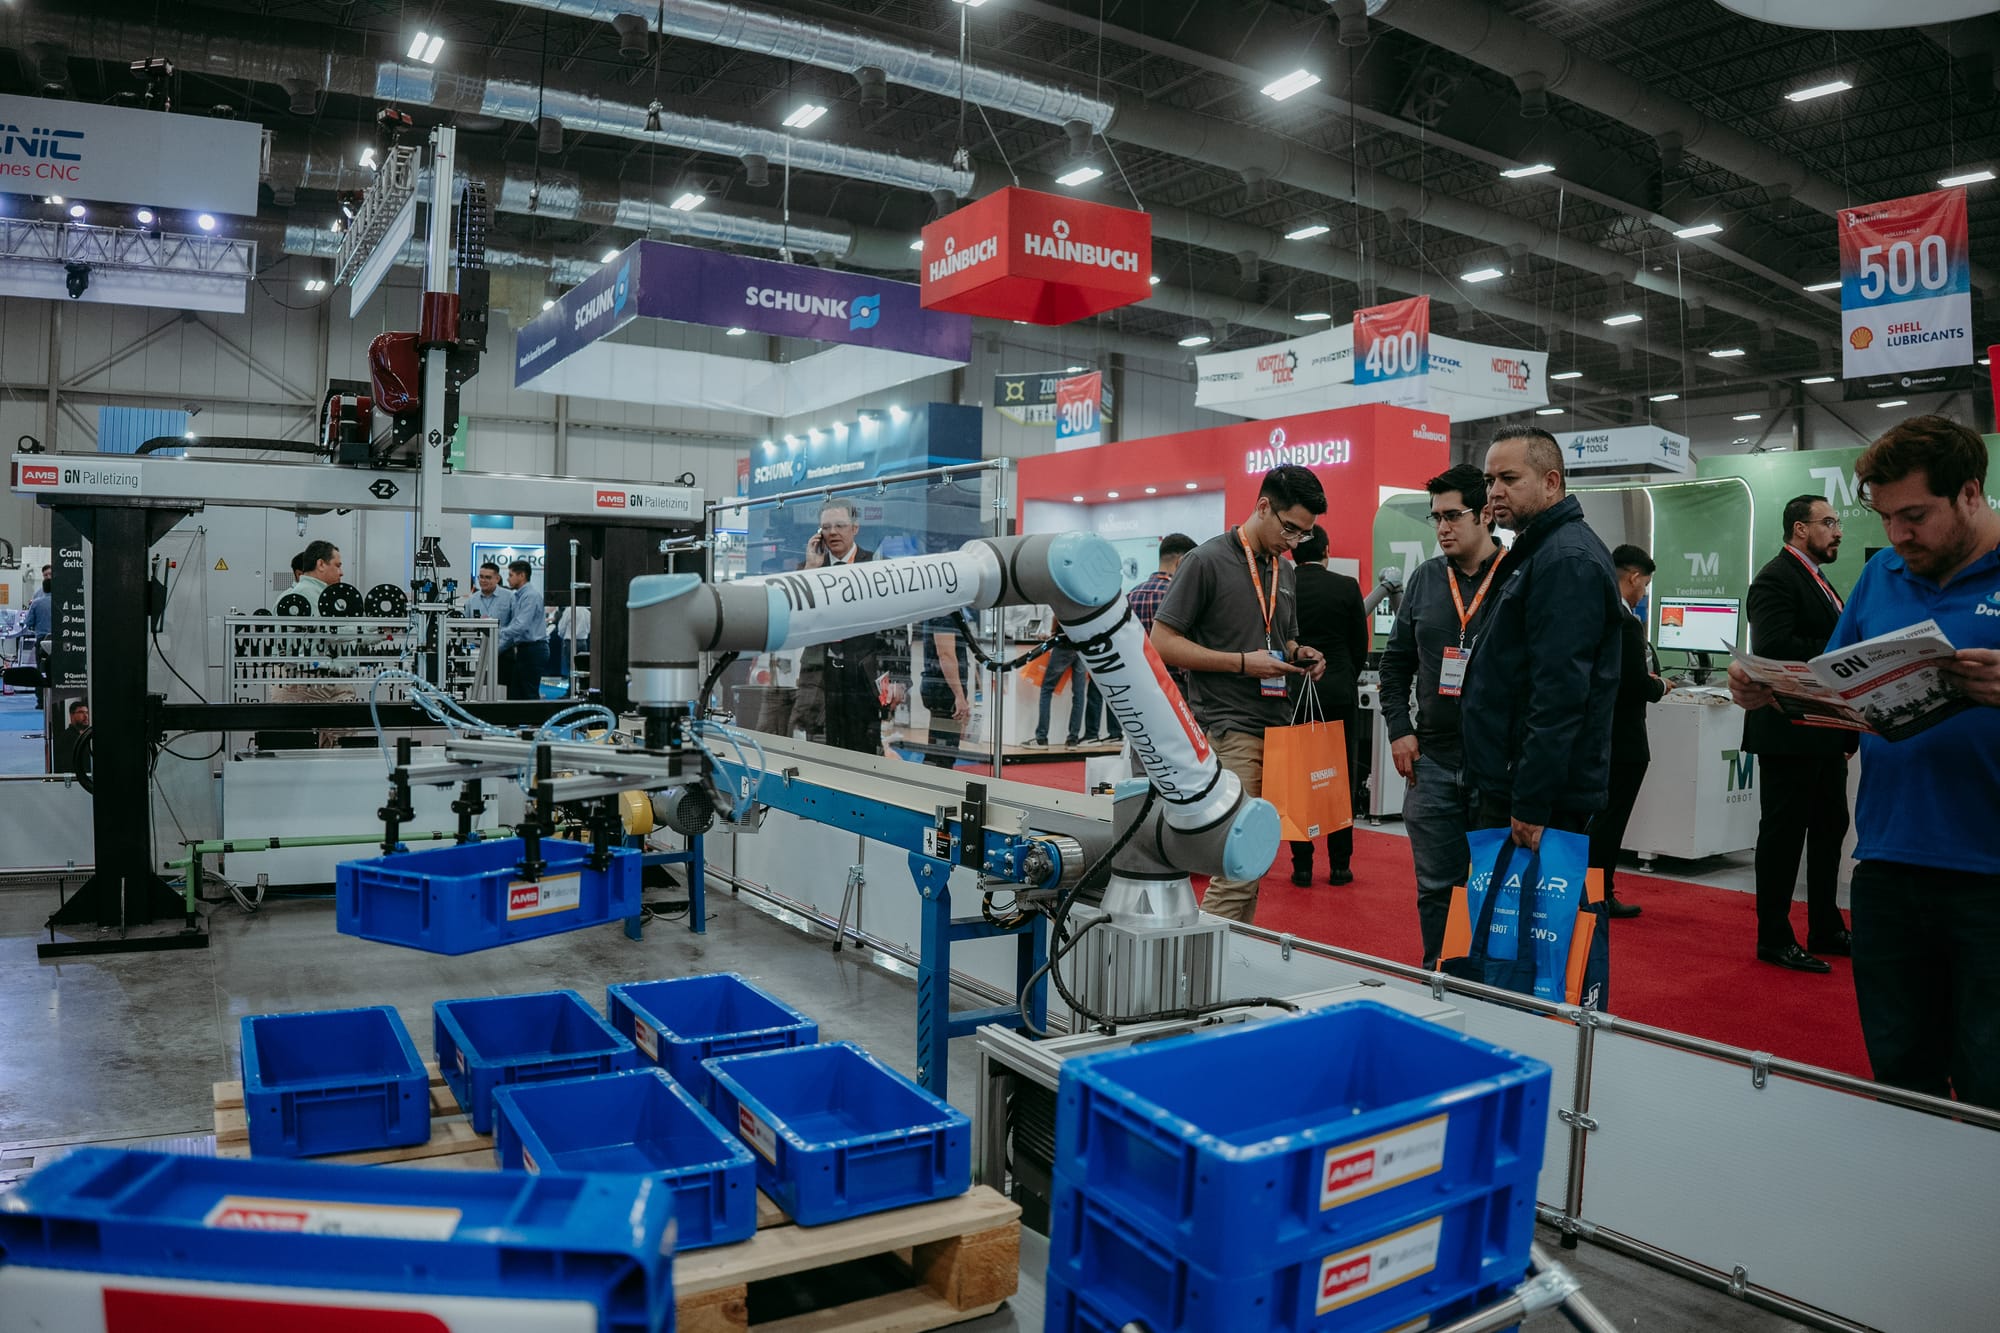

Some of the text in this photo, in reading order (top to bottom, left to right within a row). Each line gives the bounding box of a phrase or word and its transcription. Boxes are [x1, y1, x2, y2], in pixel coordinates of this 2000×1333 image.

[0, 124, 84, 161] NIC
[36, 163, 80, 182] CNC
[929, 235, 997, 282] HAINBUCH
[1024, 232, 1139, 273] HAINBUCH
[1859, 234, 1948, 300] 500
[574, 285, 615, 331] SCHUNK
[745, 286, 848, 319] SCHUNK
[1887, 321, 1922, 335] SHELL
[1887, 328, 1964, 347] LUBRICANTS
[1256, 353, 1286, 373] NORTH
[1364, 330, 1417, 378] 400
[1429, 352, 1462, 368] TOOL
[1491, 357, 1520, 374] NORTH
[1272, 367, 1294, 385] TOOL
[1507, 374, 1528, 390] TOOL
[1061, 399, 1093, 435] 300
[1246, 438, 1350, 474] HAINBUCH
[1586, 444, 1608, 454] TOOLS
[24, 469, 138, 488] AMS ON Palletizing
[754, 461, 794, 484] SCHUNK
[599, 494, 688, 511] AMS ON Palletizing
[1684, 552, 1720, 576] TM
[817, 561, 958, 606] Palletizing
[1676, 586, 1725, 596] Techman AI
[1905, 625, 1936, 639] SYSTEMS
[1831, 655, 1869, 679] ON
[1867, 648, 1907, 664] Industry
[1100, 683, 1184, 802] Automation
[1721, 750, 1754, 791] TM
[1727, 793, 1752, 803] ROBOT
[512, 892, 538, 905] AMS
[1329, 1157, 1372, 1183] AMS
[1326, 1262, 1368, 1287] AMS
